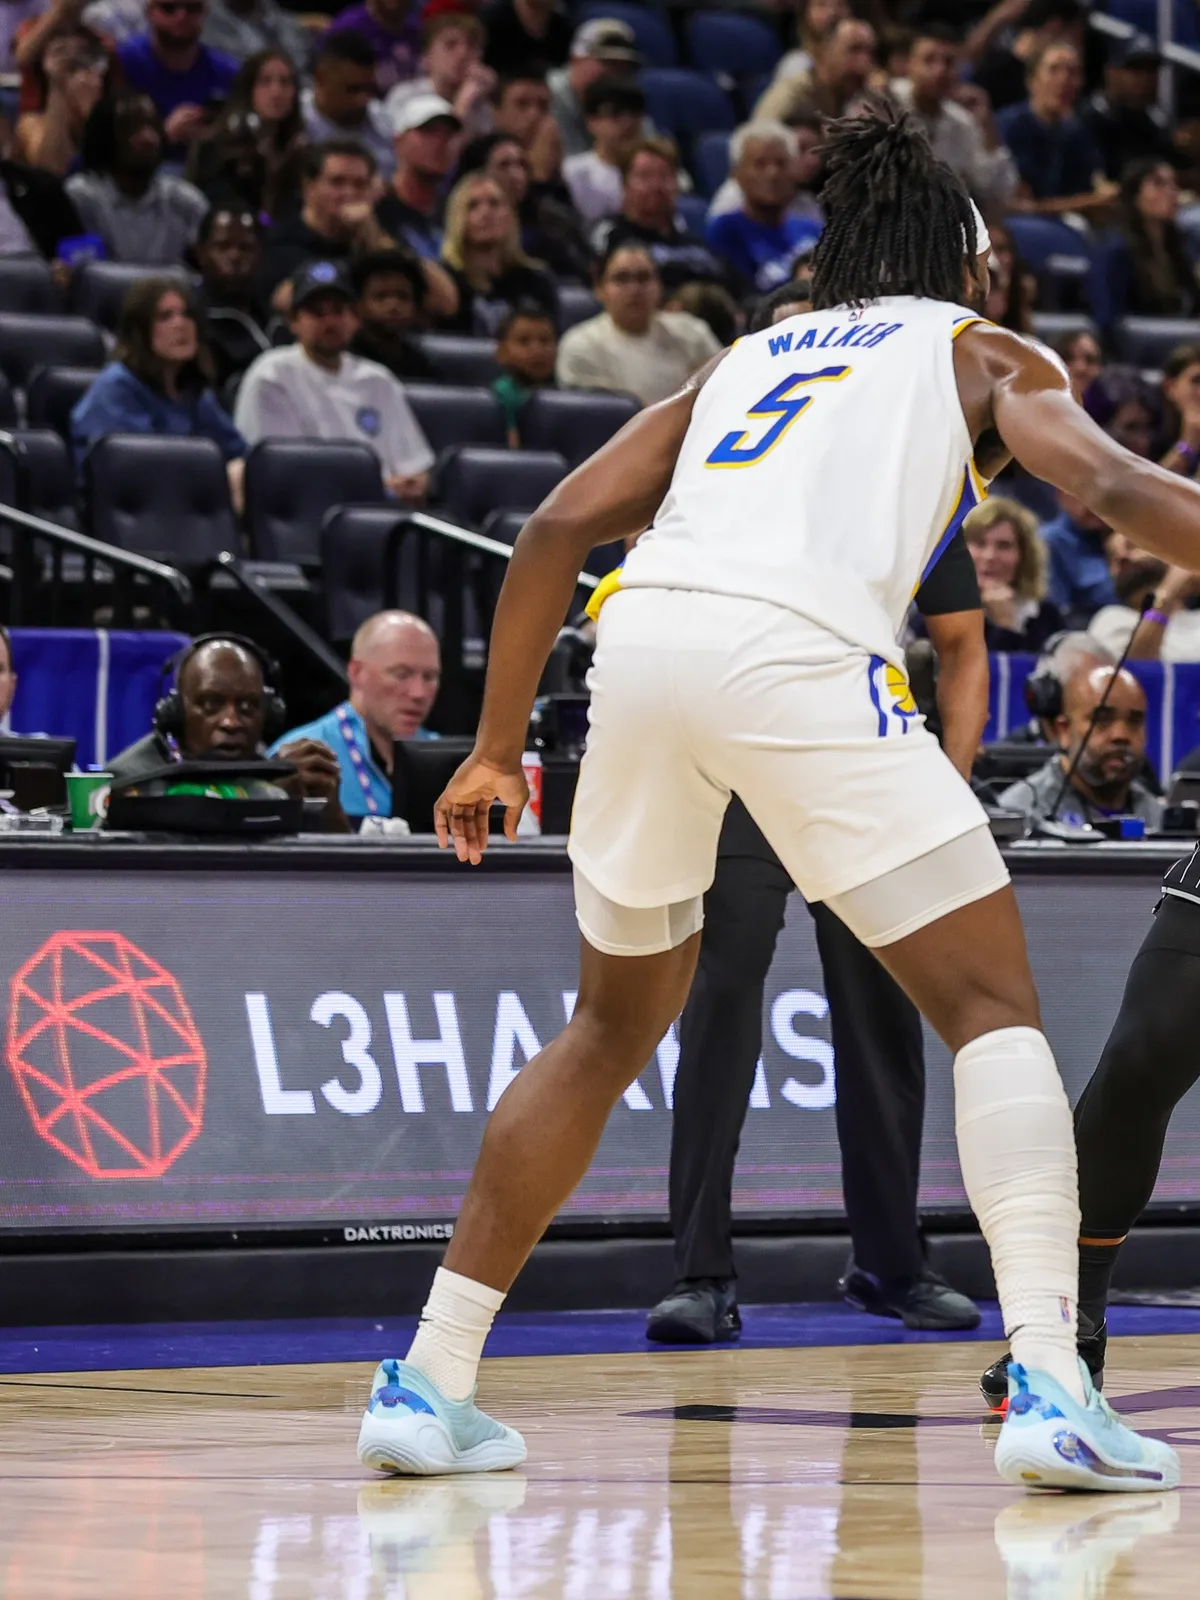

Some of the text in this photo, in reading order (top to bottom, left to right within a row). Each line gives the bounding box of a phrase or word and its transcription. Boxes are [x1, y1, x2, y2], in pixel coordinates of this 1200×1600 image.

[768, 322, 904, 358] WALKER
[704, 365, 853, 469] 5
[245, 989, 838, 1115] L3HAS
[344, 1223, 454, 1241] DAKTRONICS
